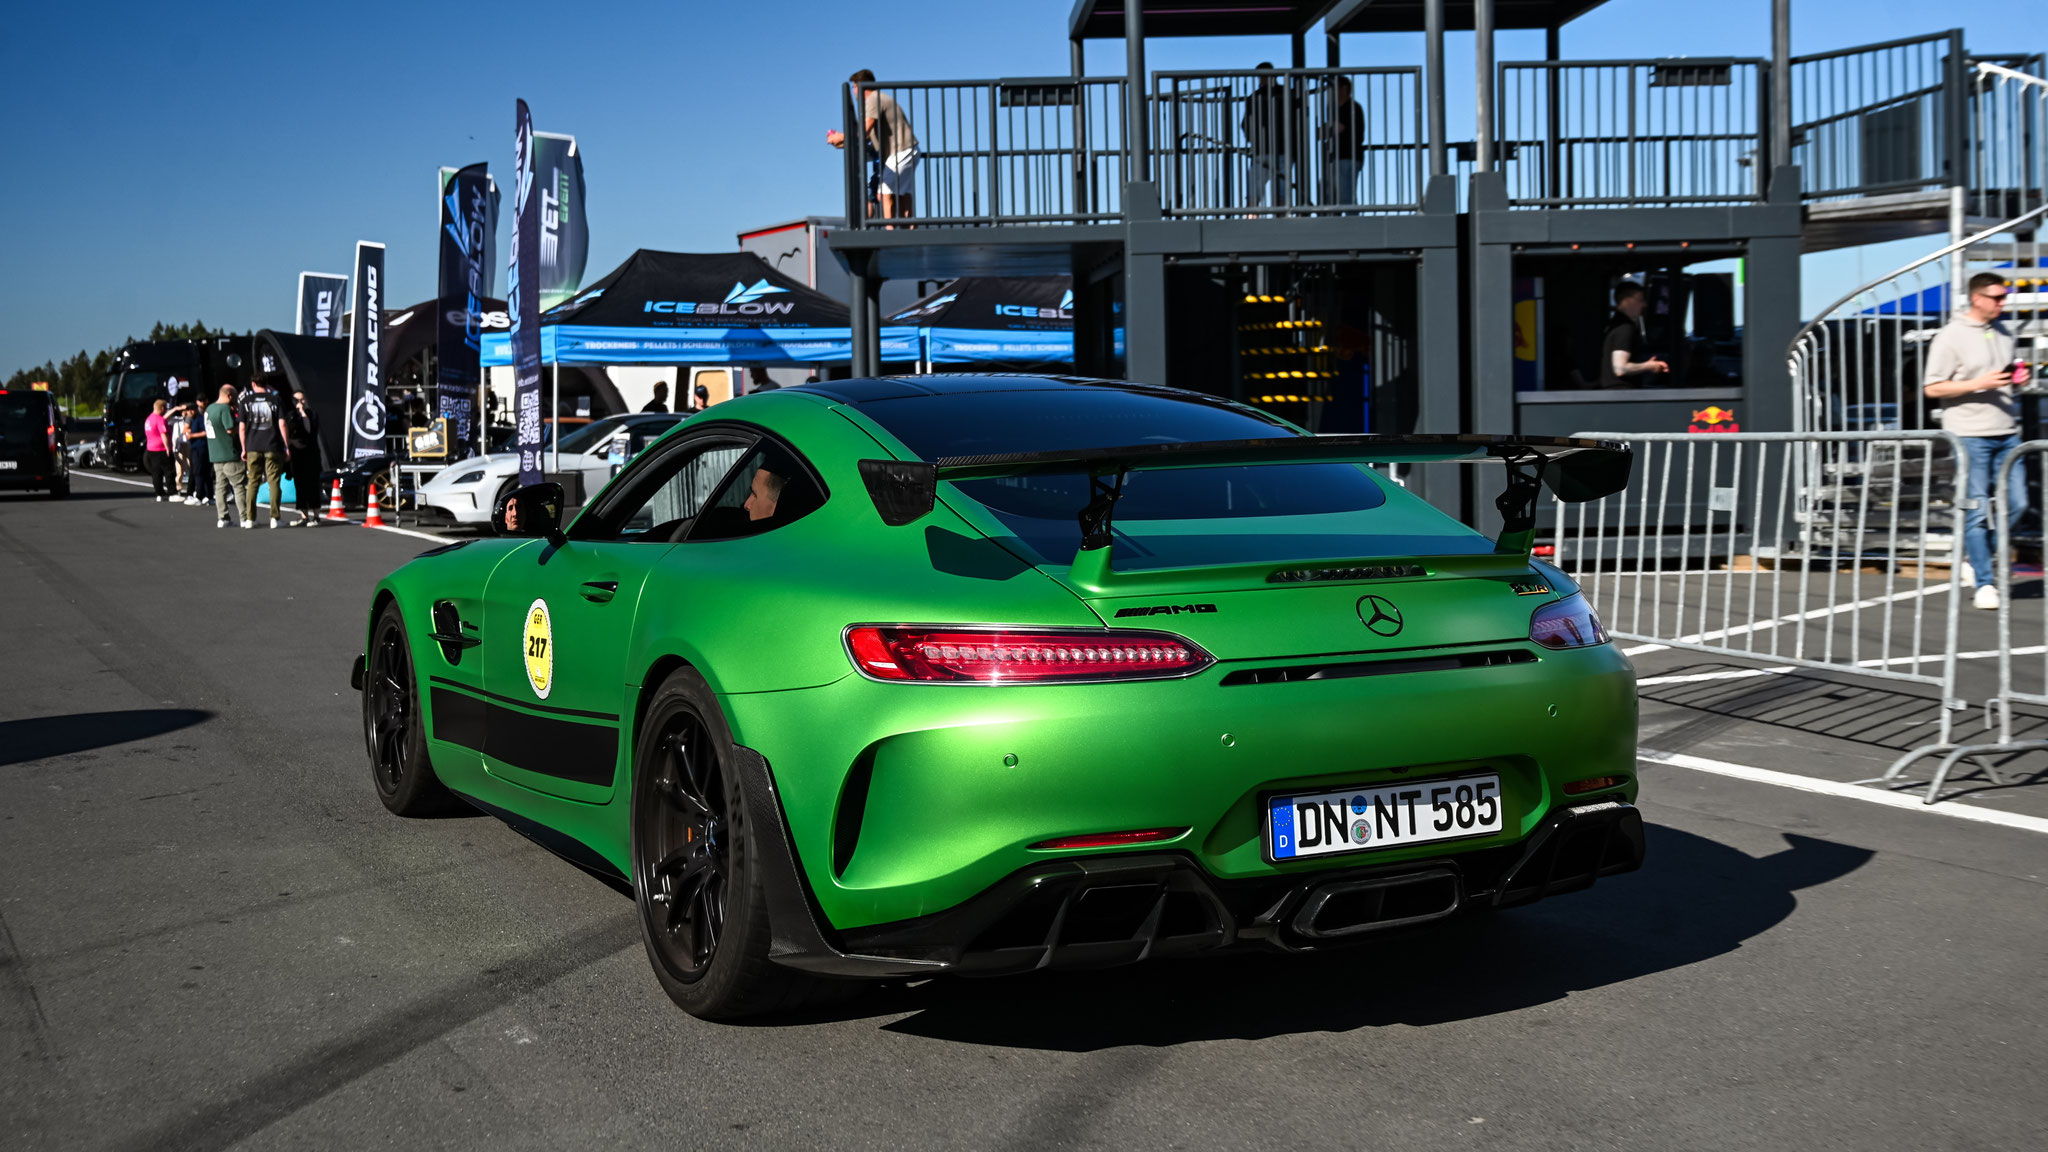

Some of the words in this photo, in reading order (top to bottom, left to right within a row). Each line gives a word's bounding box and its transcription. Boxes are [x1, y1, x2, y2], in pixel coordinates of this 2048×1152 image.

[558, 170, 570, 224] EVENT
[464, 184, 486, 351] ICEBLOW
[644, 301, 795, 315] ICEBLOW
[995, 304, 1074, 319] ICEBL
[367, 264, 379, 386] RACING
[1148, 604, 1217, 616] AMG
[529, 635, 547, 659] 217
[1297, 799, 1349, 848] DN
[1374, 790, 1422, 839] NT
[1431, 782, 1497, 832] 585
[1279, 834, 1288, 848] D
